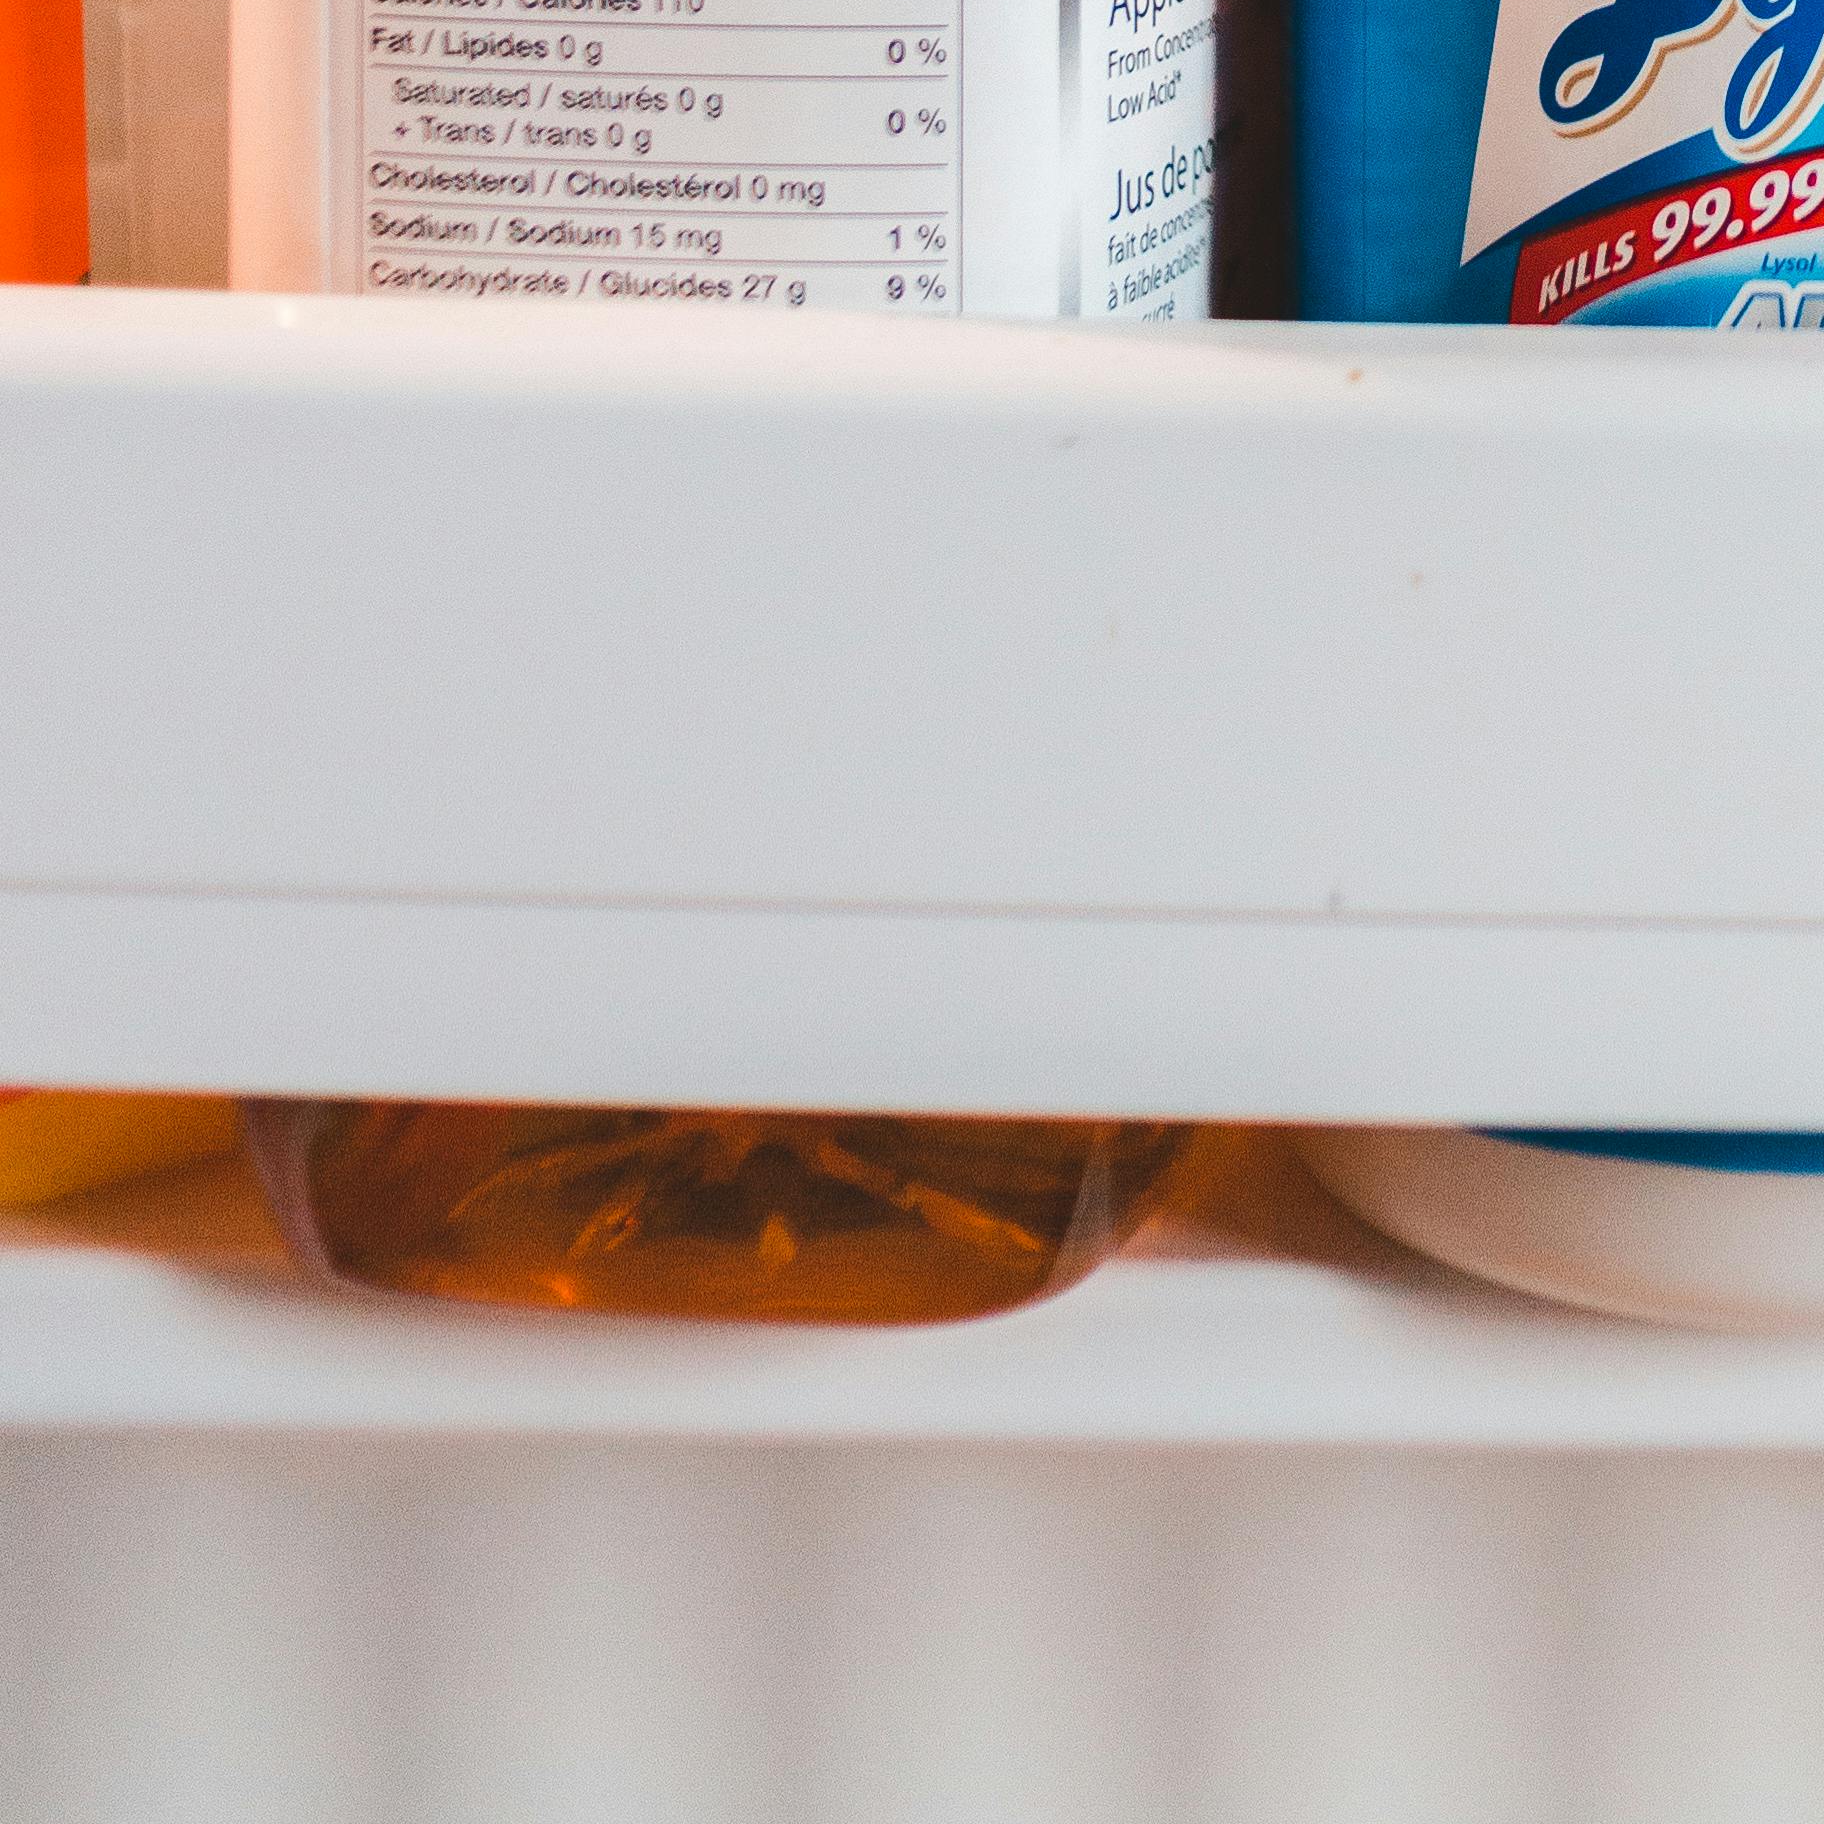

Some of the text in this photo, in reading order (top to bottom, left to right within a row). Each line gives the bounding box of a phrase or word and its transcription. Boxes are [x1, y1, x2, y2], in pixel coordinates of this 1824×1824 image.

[370, 26, 948, 67] Fat / Lipides 0 g 0 %
[1107, 46, 1151, 81] From
[393, 76, 724, 120] Saturated / saturés 0 g
[1107, 90, 1144, 125] Low
[417, 114, 497, 145] Trans
[501, 118, 517, 146] /
[523, 120, 598, 148] trans
[606, 121, 625, 149] 0
[633, 127, 652, 156] g
[887, 107, 947, 136] 0 %
[369, 161, 827, 208] Cholesterol / Cholestérol 0 mg
[1108, 168, 1155, 222] Jus
[1161, 144, 1188, 199] de
[368, 209, 947, 256] Sodium / Sodium 15 mg 1 %
[1107, 231, 1137, 268] fait
[1140, 220, 1158, 254] de
[368, 259, 947, 308] Carbohydrate / Glucides 27 g 9 %
[1537, 229, 1638, 314] KILLS
[1760, 251, 1818, 275] Lysol
[1107, 281, 1120, 312] à
[1122, 263, 1162, 306] faible
